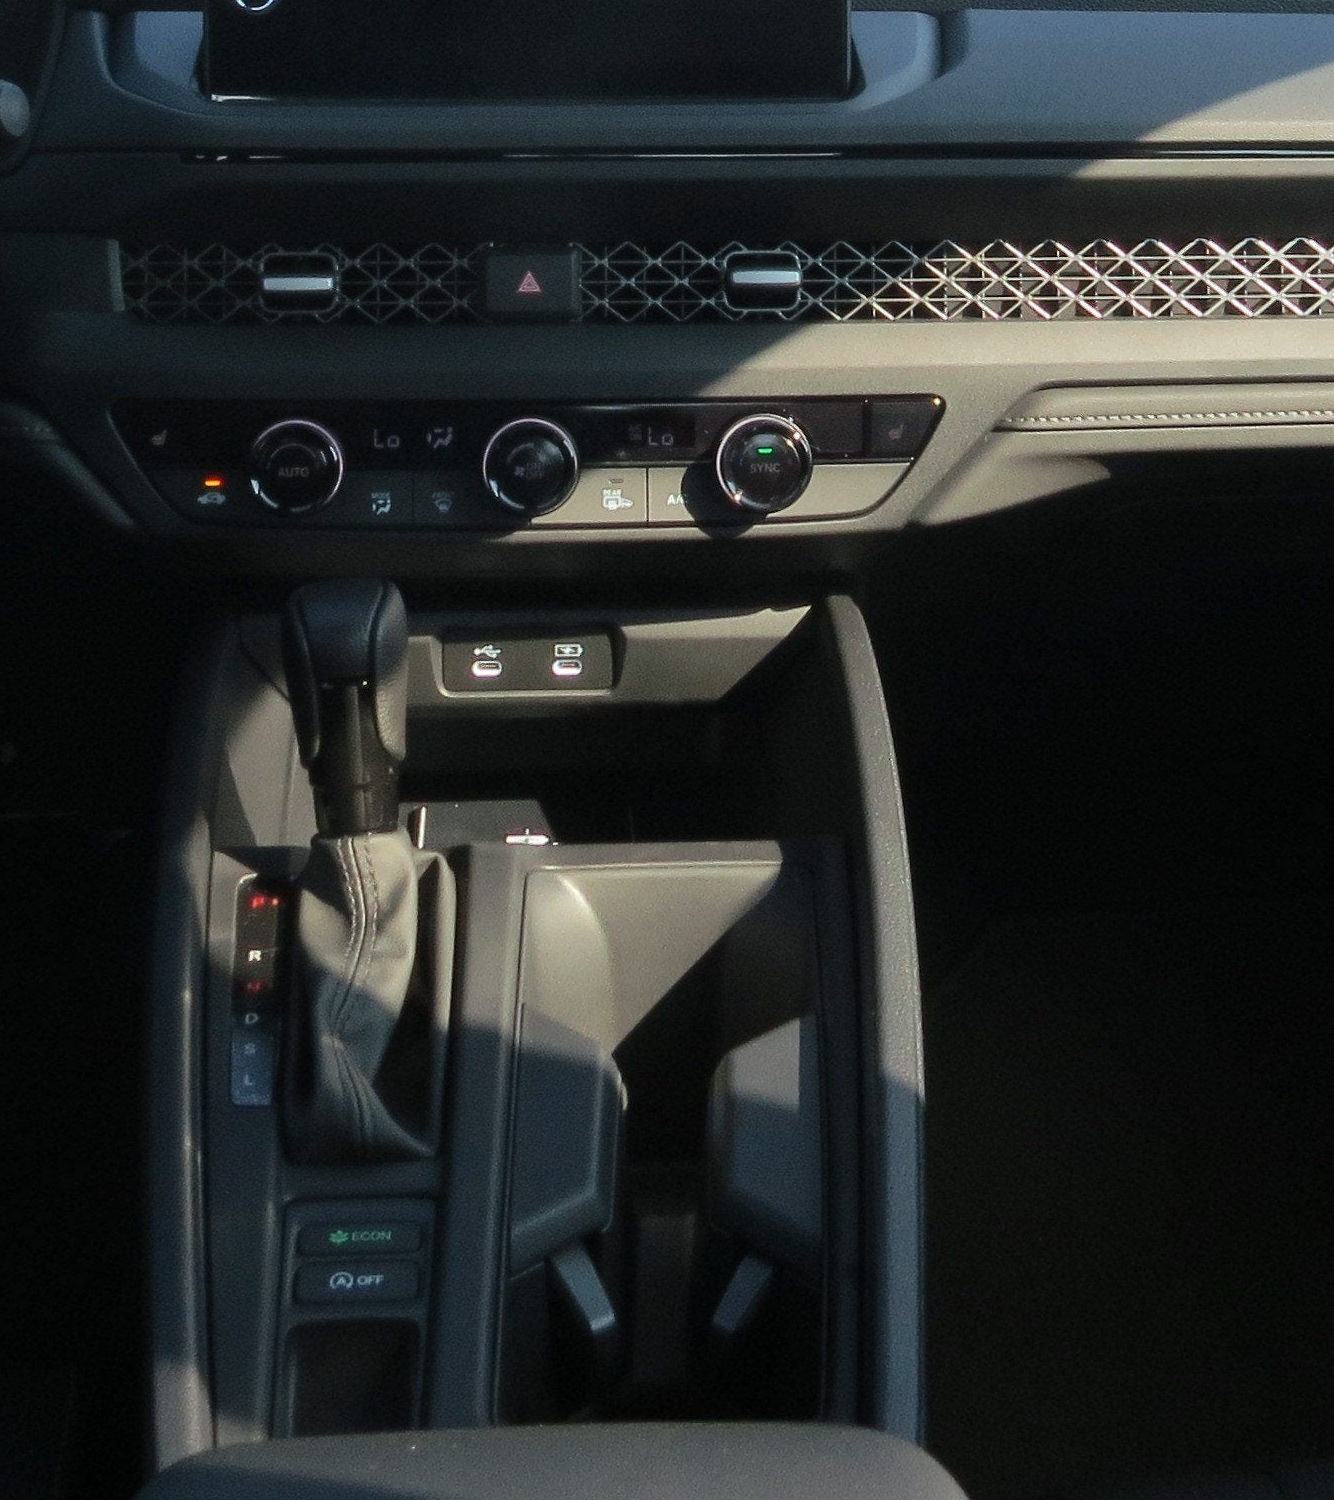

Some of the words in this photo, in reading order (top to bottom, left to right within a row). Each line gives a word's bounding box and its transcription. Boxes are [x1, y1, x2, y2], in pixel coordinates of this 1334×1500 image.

[373, 428, 400, 448] Lo
[648, 426, 674, 446] Lo
[278, 467, 309, 478] AUTO
[750, 463, 780, 474] SYNC
[248, 949, 262, 962] R
[245, 1013, 259, 1025] D
[244, 1074, 254, 1086] L
[351, 1230, 392, 1242] ECON
[357, 1274, 384, 1286] OFF
